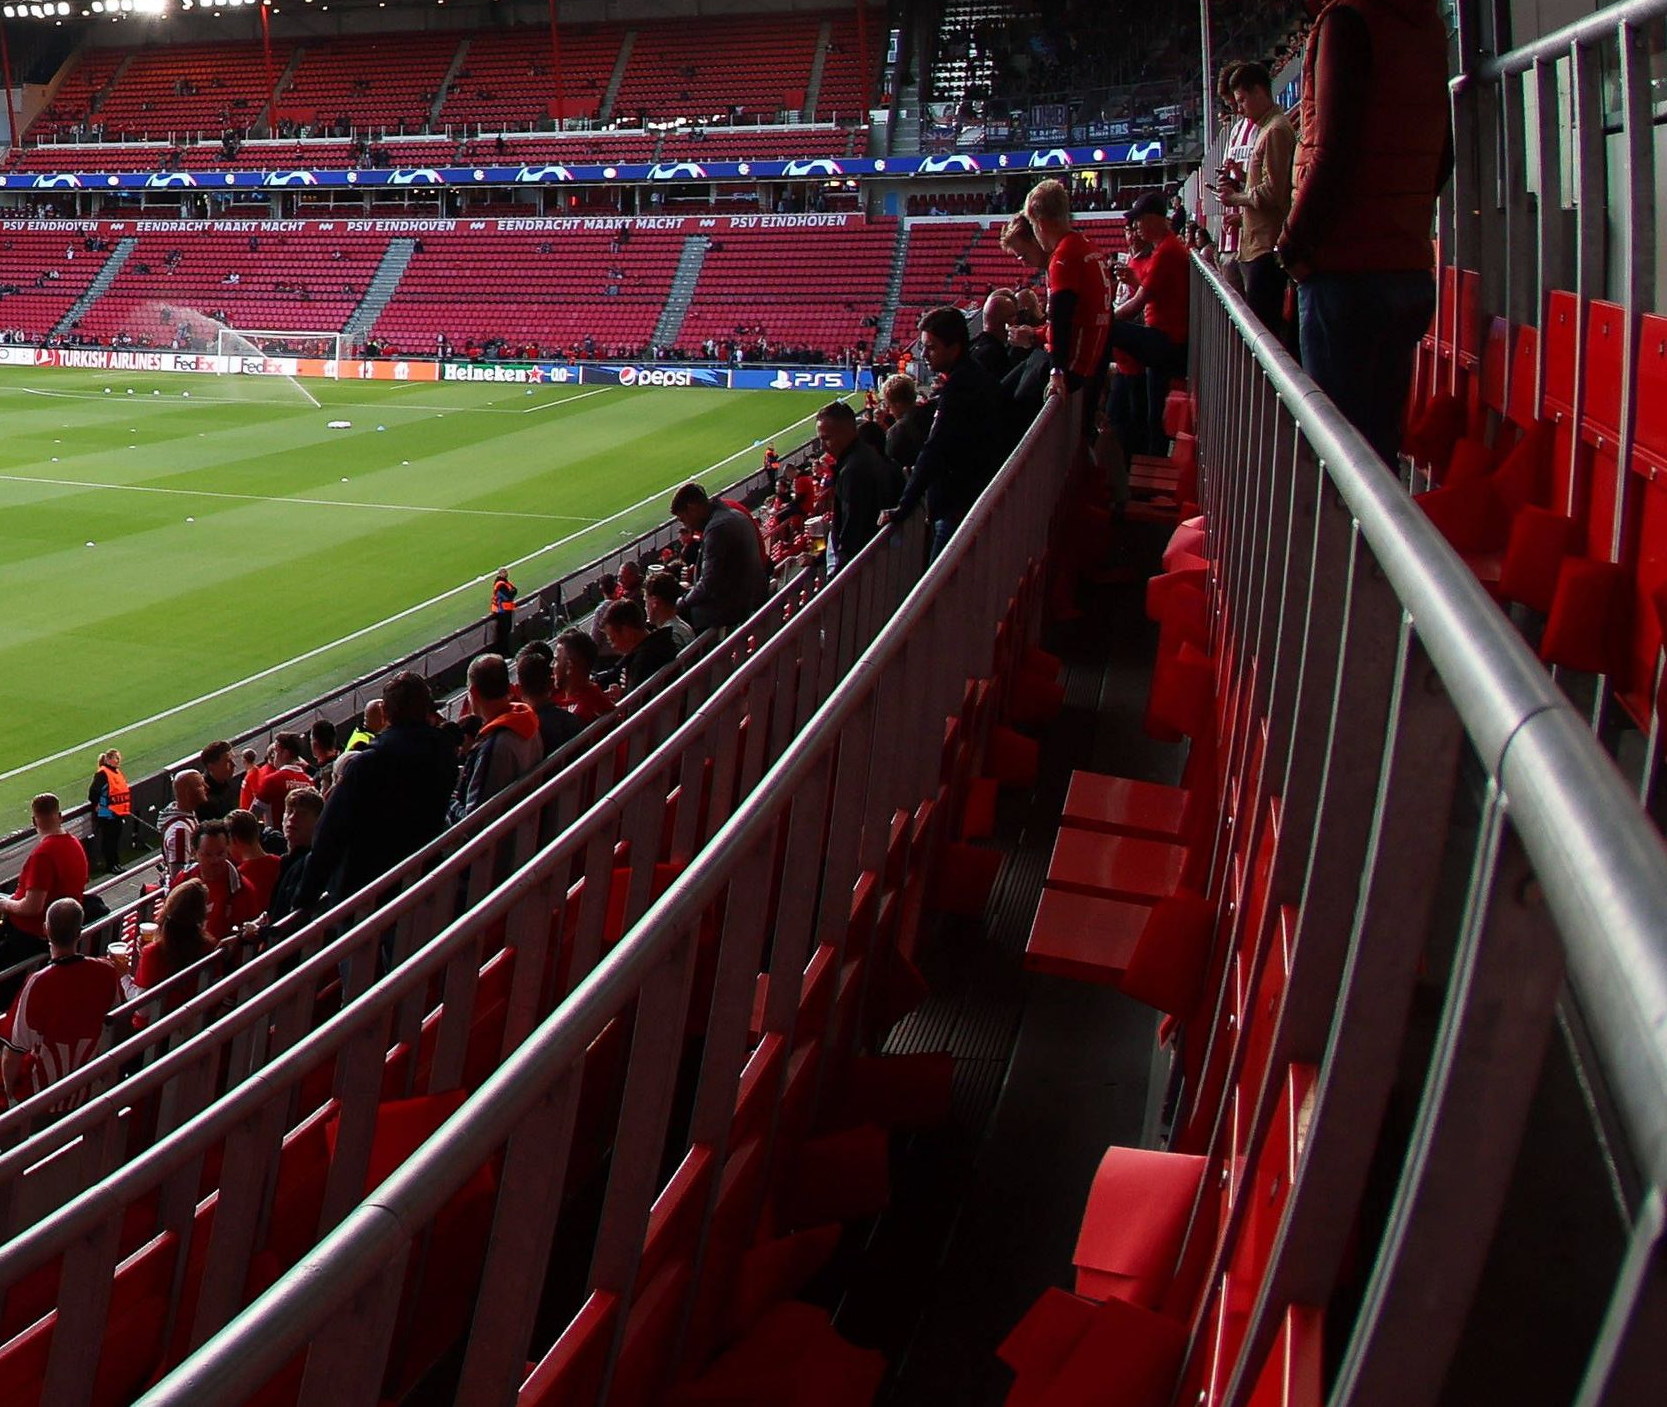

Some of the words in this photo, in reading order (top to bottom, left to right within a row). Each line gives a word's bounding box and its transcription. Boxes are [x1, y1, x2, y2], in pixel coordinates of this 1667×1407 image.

[3, 221, 25, 231] PSV
[27, 221, 98, 231] EINDHOVEN
[136, 221, 210, 231] EENDRACHT
[214, 221, 259, 231] MAAKT
[260, 221, 305, 231] MACHT
[347, 221, 372, 232] PSV
[375, 220, 456, 231] EINDHOVEN
[497, 219, 578, 231] EENDRACHT
[584, 218, 633, 230] MAAKT
[635, 218, 684, 229] MACHT
[730, 216, 760, 228] PSV
[761, 215, 847, 227] EINDHOVEN
[58, 351, 107, 368] TURKISH
[108, 352, 161, 370] AIRLINES
[174, 356, 214, 371] FedEx
[241, 357, 283, 373] FedEx
[444, 363, 527, 383] Heineken
[639, 368, 692, 387] pepsi
[794, 373, 843, 387] PS5
